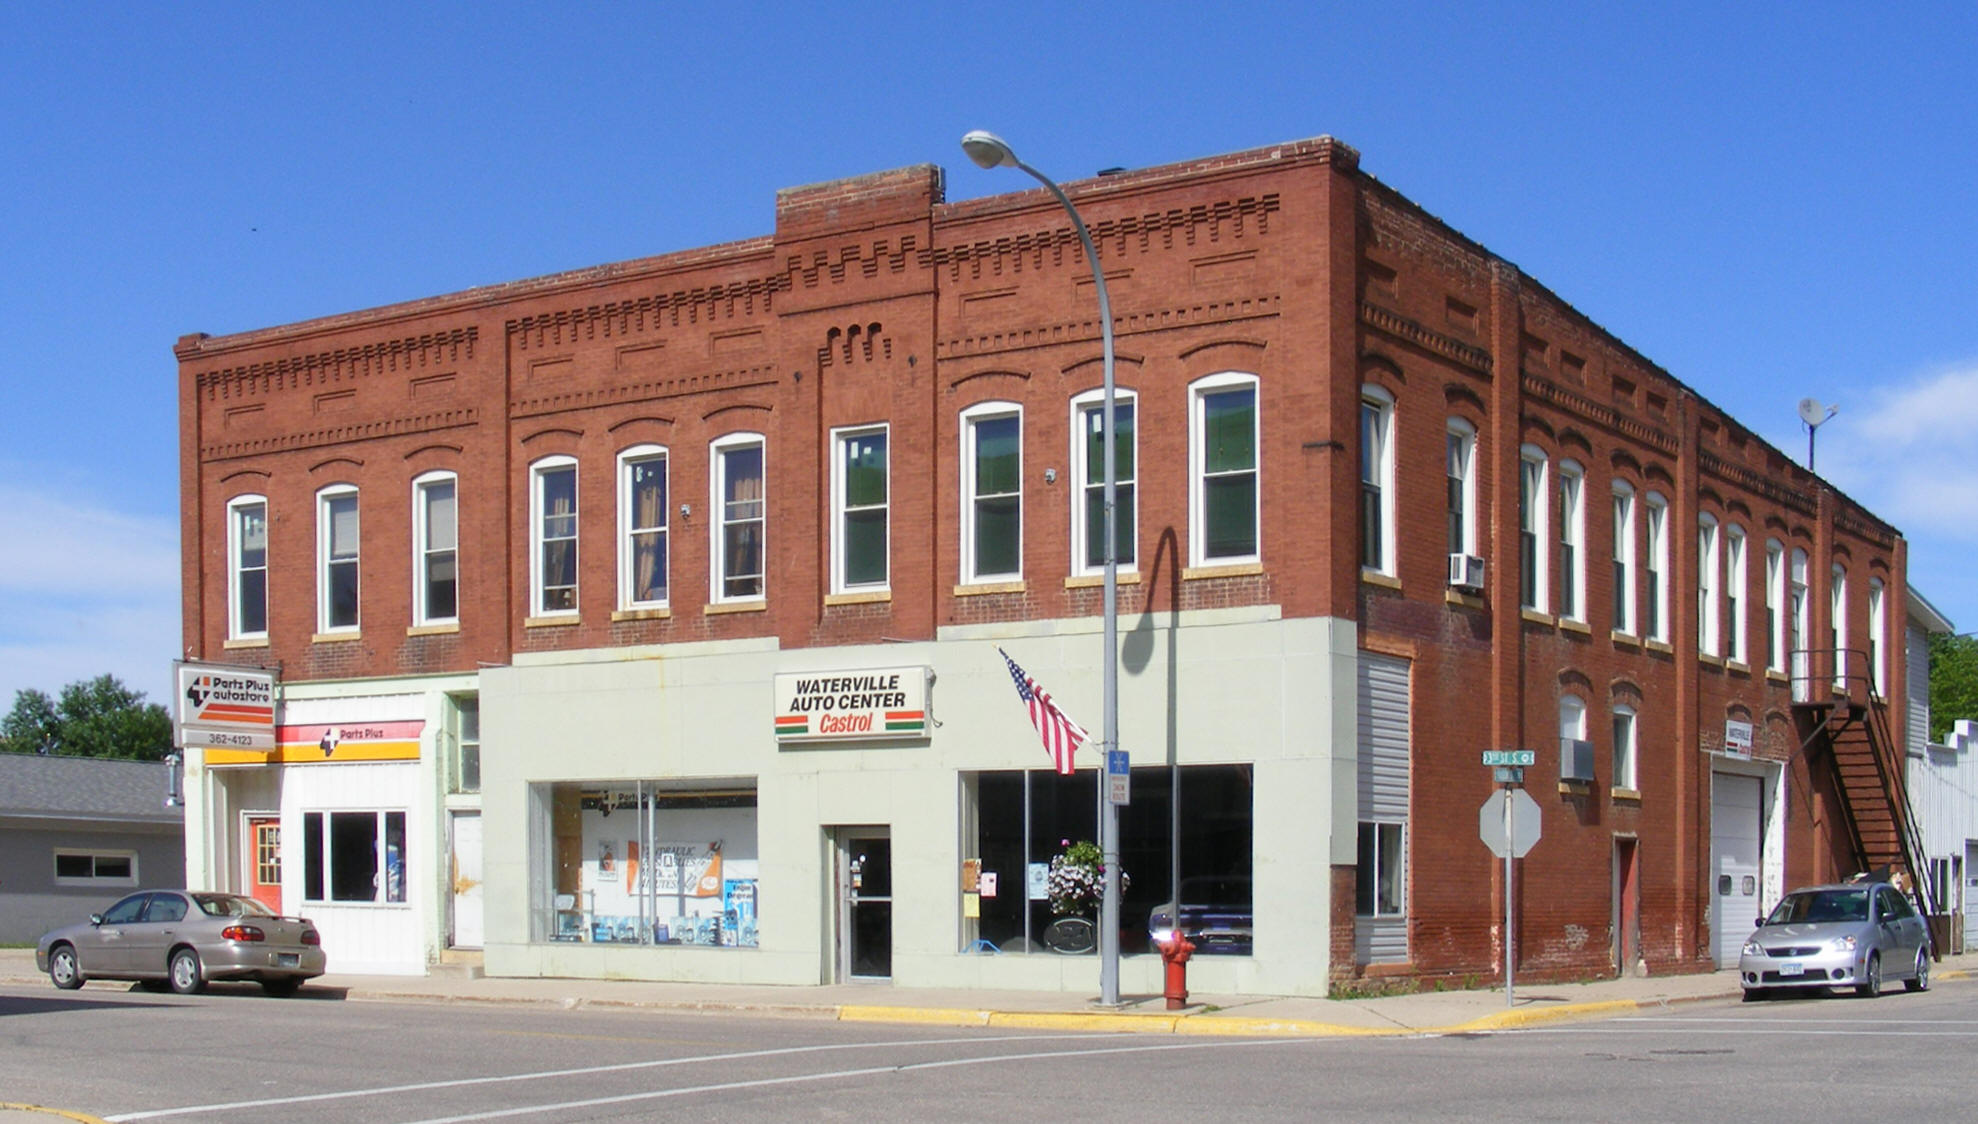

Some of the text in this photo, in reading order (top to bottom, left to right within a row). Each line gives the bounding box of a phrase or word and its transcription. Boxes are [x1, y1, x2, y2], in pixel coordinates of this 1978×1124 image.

[213, 677, 269, 691] Parts Plus
[796, 675, 899, 694] WATERVILLE
[213, 690, 269, 702] autostore
[790, 692, 905, 712] AUTO CENTER
[820, 712, 873, 733] Castrol
[209, 734, 252, 745] 362-4123
[340, 728, 383, 739] Parts Plus
